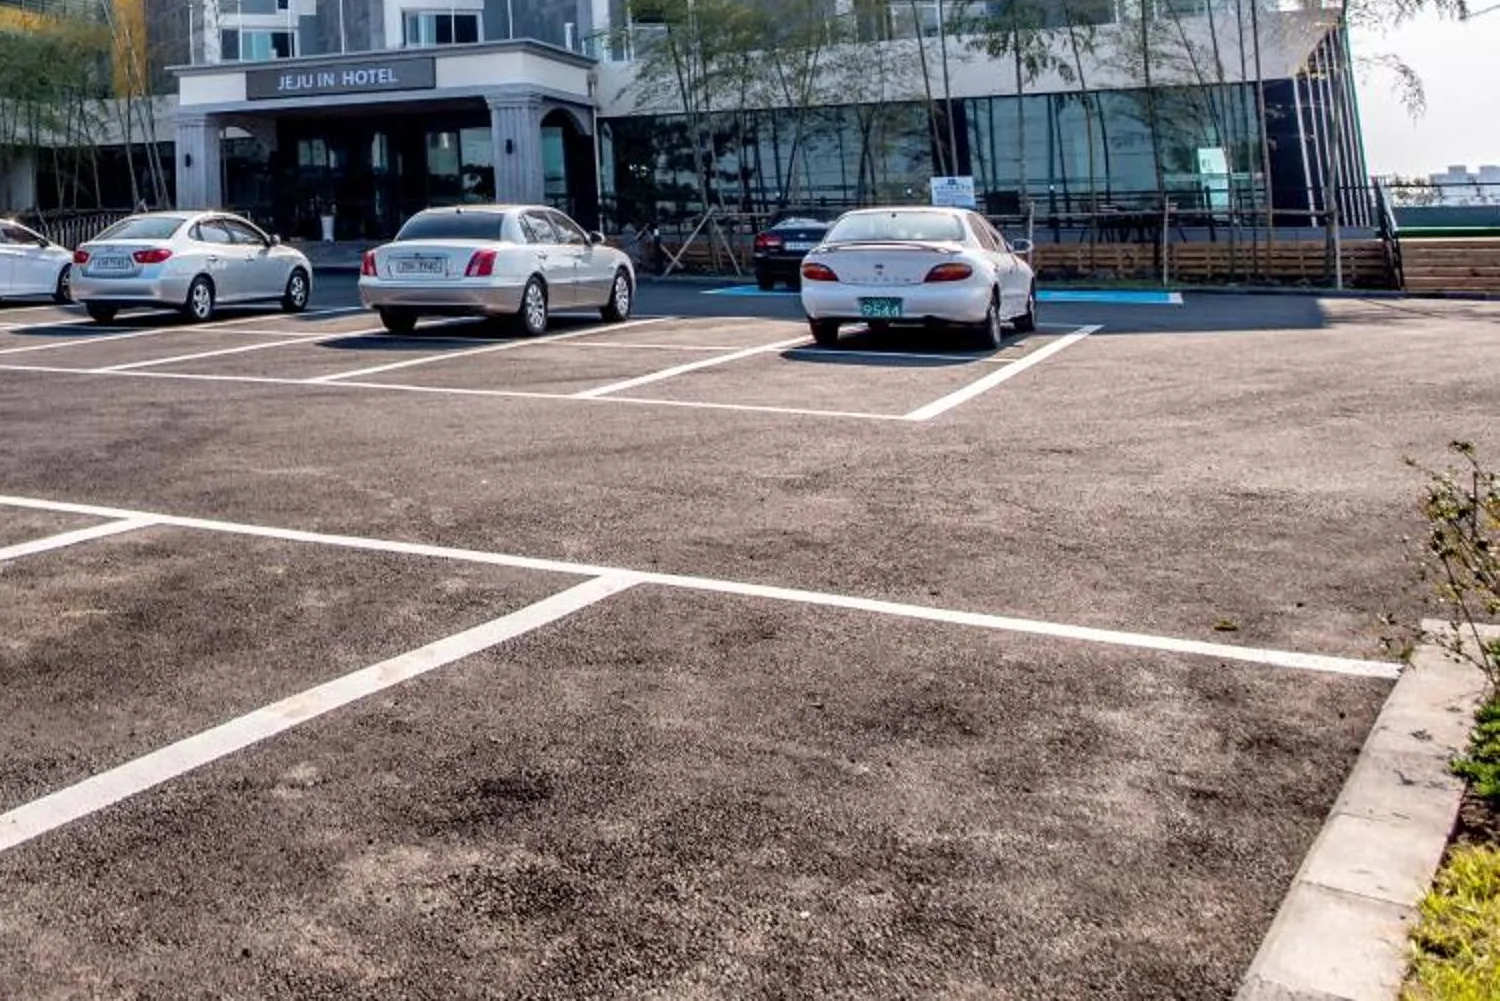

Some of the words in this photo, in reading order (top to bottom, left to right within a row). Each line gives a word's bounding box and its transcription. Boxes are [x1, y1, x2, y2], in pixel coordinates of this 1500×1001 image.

[277, 73, 313, 90] JEJU
[317, 72, 335, 87] IN
[342, 68, 399, 86] HOTEL
